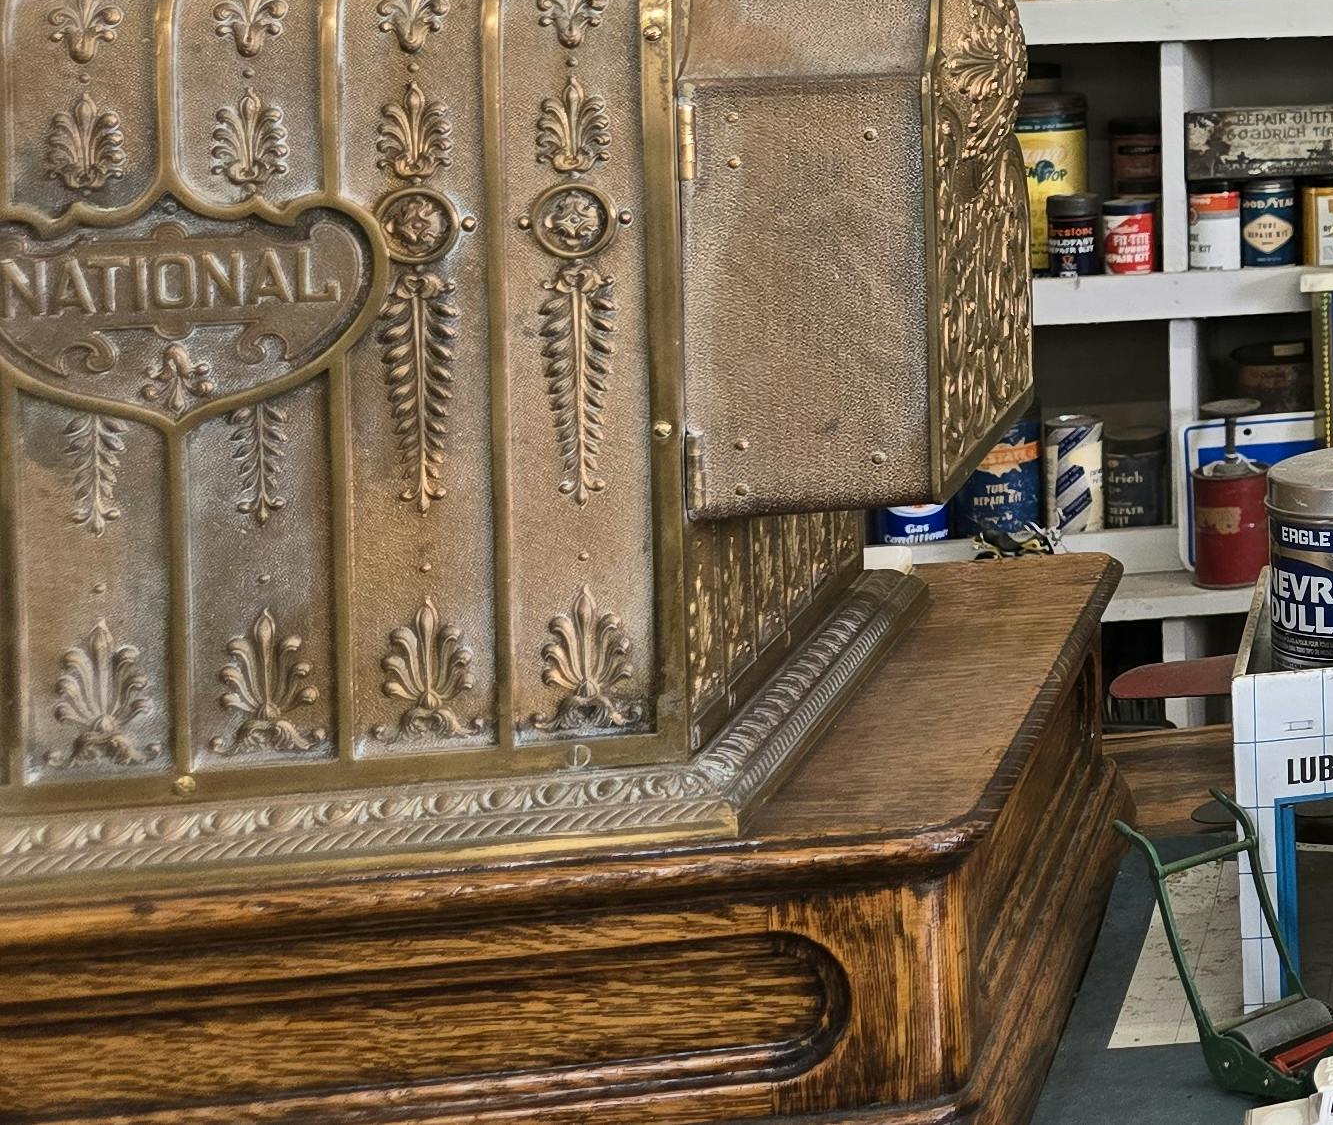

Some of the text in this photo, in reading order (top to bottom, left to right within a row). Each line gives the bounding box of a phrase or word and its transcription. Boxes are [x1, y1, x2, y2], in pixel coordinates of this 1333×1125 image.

[1236, 113, 1287, 125] REPAIR
[1226, 128, 1306, 141] GOODRICH
[0, 250, 341, 320] NATIONAL
[985, 484, 1009, 493] TUBE
[904, 523, 930, 534] Gas
[1282, 526, 1331, 547] EAGLE
